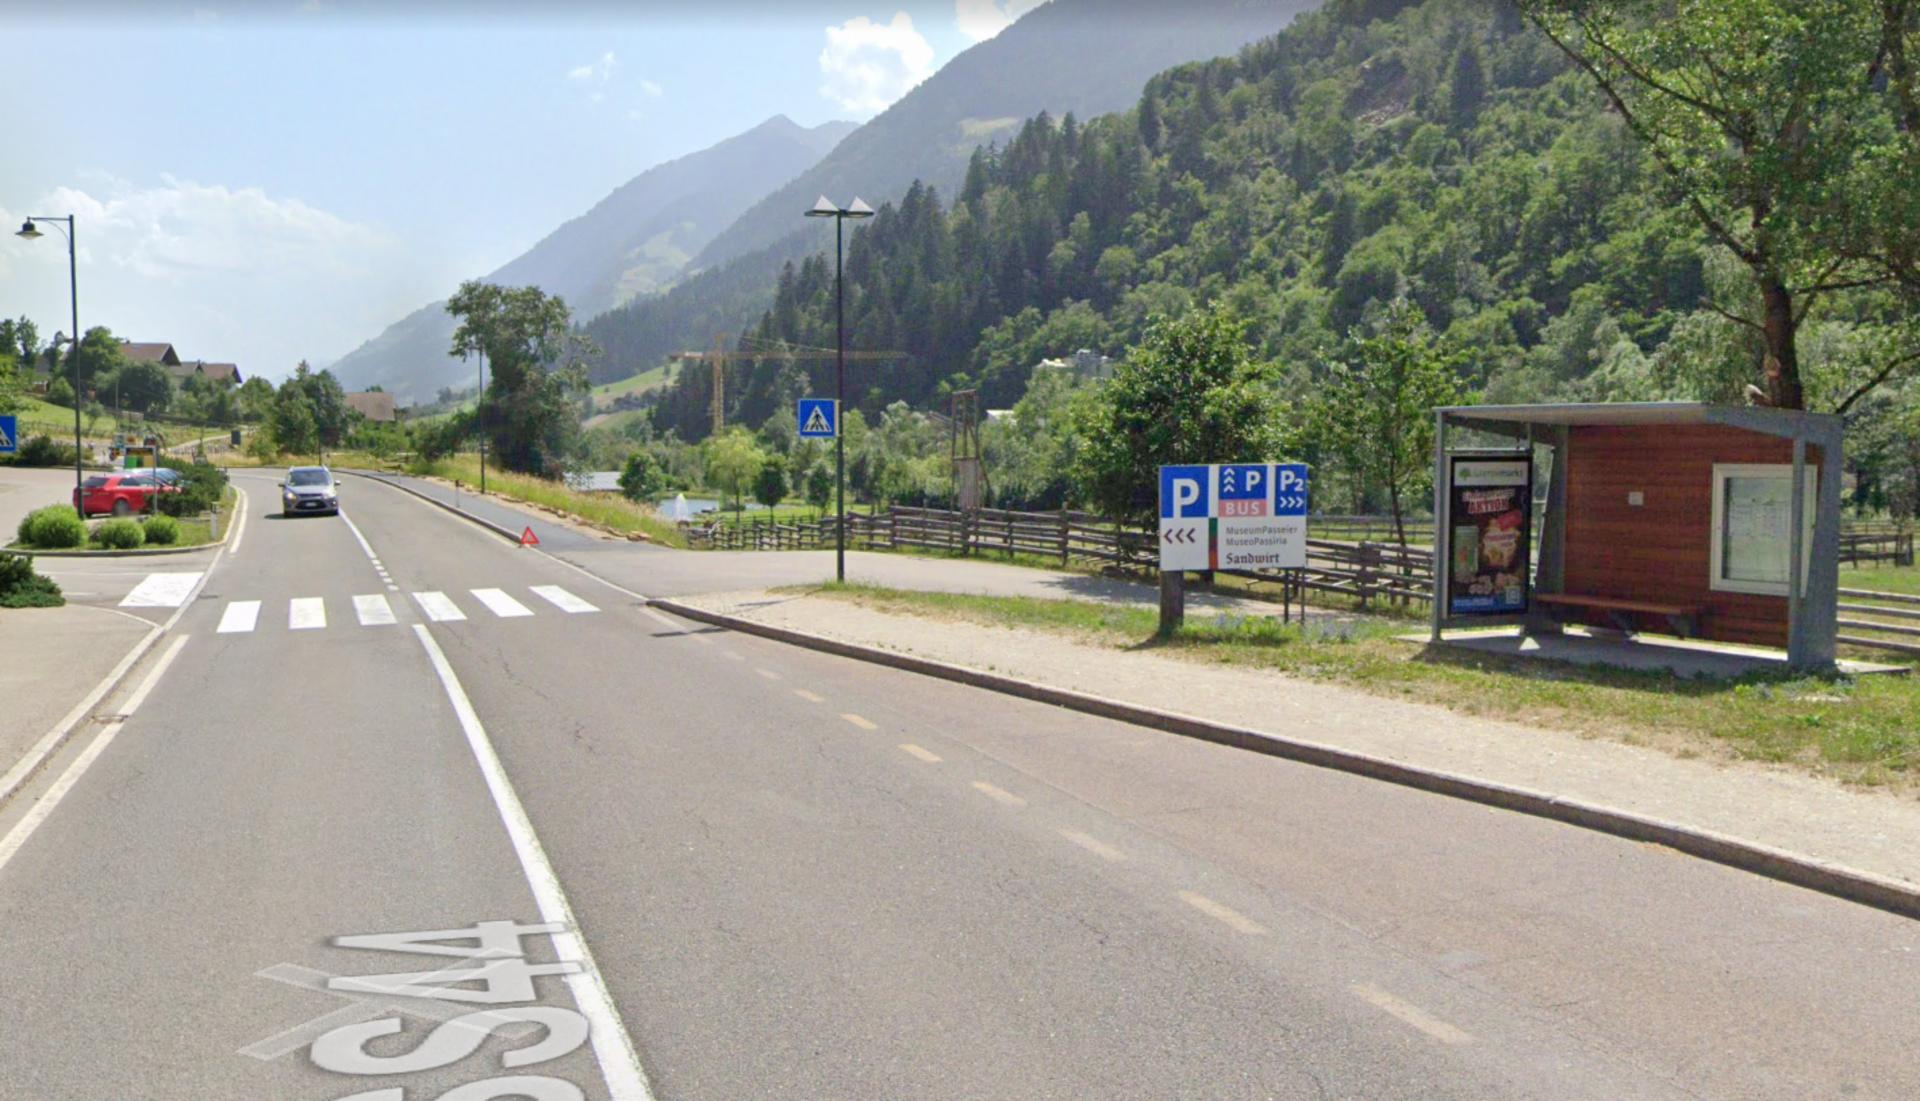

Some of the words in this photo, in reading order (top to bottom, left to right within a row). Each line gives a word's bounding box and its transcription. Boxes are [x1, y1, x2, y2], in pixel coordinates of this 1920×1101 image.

[1246, 470, 1261, 492] P
[1280, 470, 1304, 492] P2
[1172, 478, 1200, 517] P
[1225, 502, 1260, 515] BUS
[1226, 525, 1298, 535] MuseumPasseier
[1226, 537, 1288, 546] MuseoPassiria
[1226, 552, 1280, 564] Sandwirt
